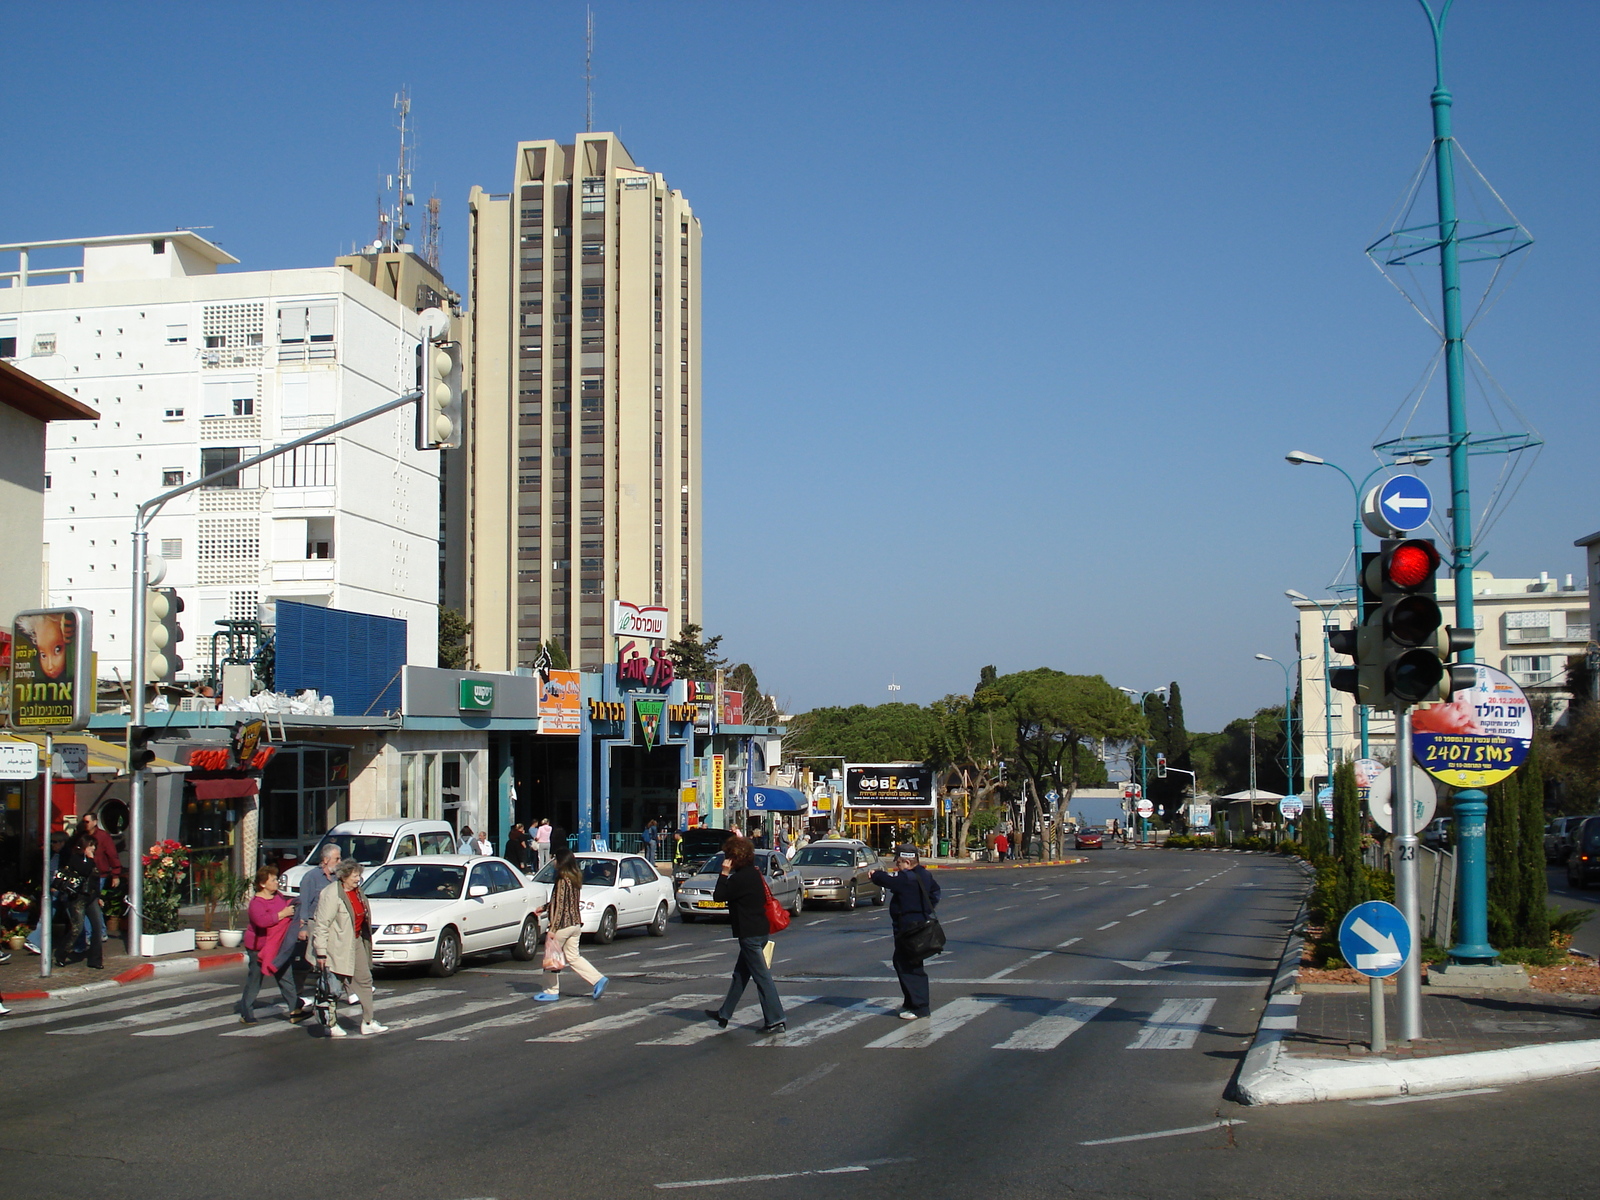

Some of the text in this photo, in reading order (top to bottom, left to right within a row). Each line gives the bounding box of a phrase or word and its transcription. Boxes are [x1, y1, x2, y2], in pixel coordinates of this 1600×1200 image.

[630, 613, 662, 633] שופרסל
[619, 641, 649, 686] FAIR
[15, 682, 72, 702] ארתור
[588, 698, 626, 721] הכרמל
[638, 703, 661, 714] Café Bar
[1488, 697, 1526, 705] 20.12.2006
[668, 703, 699, 722] ביליארד
[1474, 702, 1526, 718] יום הילד
[1426, 745, 1514, 762] 2407 SMS
[880, 776, 920, 791] BEAT
[1399, 845, 1415, 860] 23
